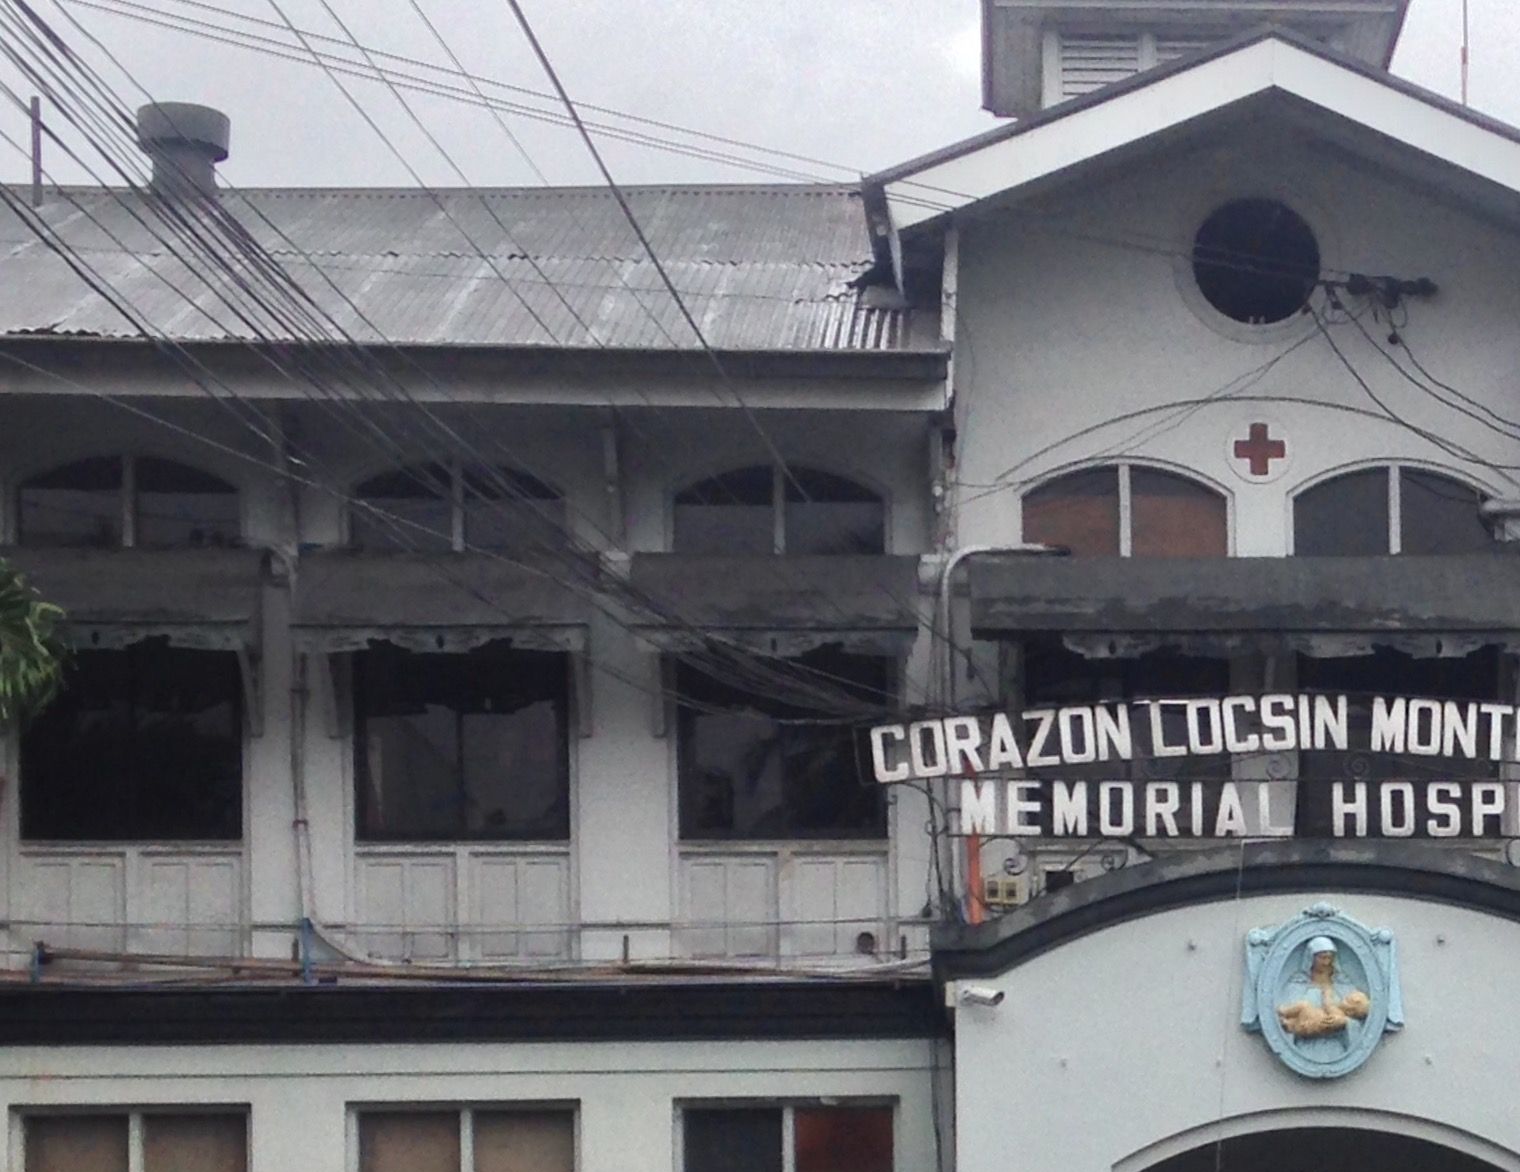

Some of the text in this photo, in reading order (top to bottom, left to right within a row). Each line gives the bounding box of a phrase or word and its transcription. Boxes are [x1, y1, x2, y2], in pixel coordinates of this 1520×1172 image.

[870, 703, 1132, 783] CORAZON
[1149, 693, 1348, 758] LOCSIN
[960, 780, 1295, 837] MEMORIAL
